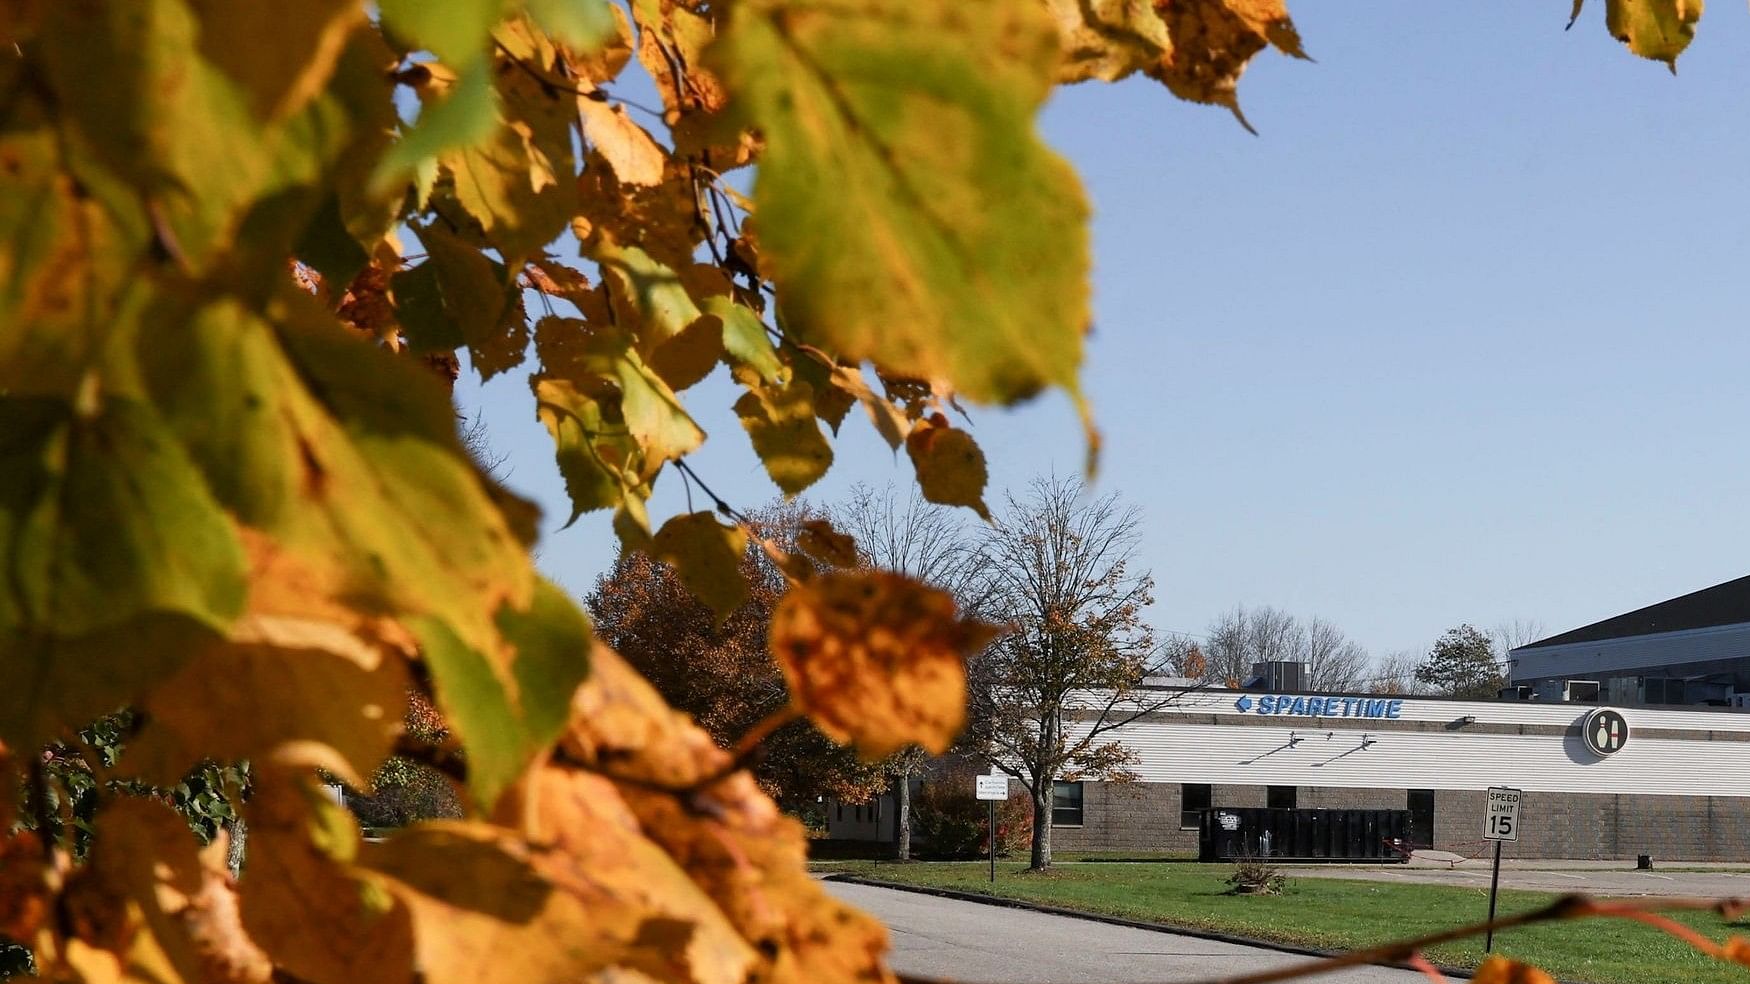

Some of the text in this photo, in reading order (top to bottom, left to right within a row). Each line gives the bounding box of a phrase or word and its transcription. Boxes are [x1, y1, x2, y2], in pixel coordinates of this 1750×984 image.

[1257, 695, 1402, 719] SPARETIME
[1490, 792, 1519, 803] SPEED
[1491, 804, 1514, 813] LIMIT
[1490, 815, 1512, 835] 15
